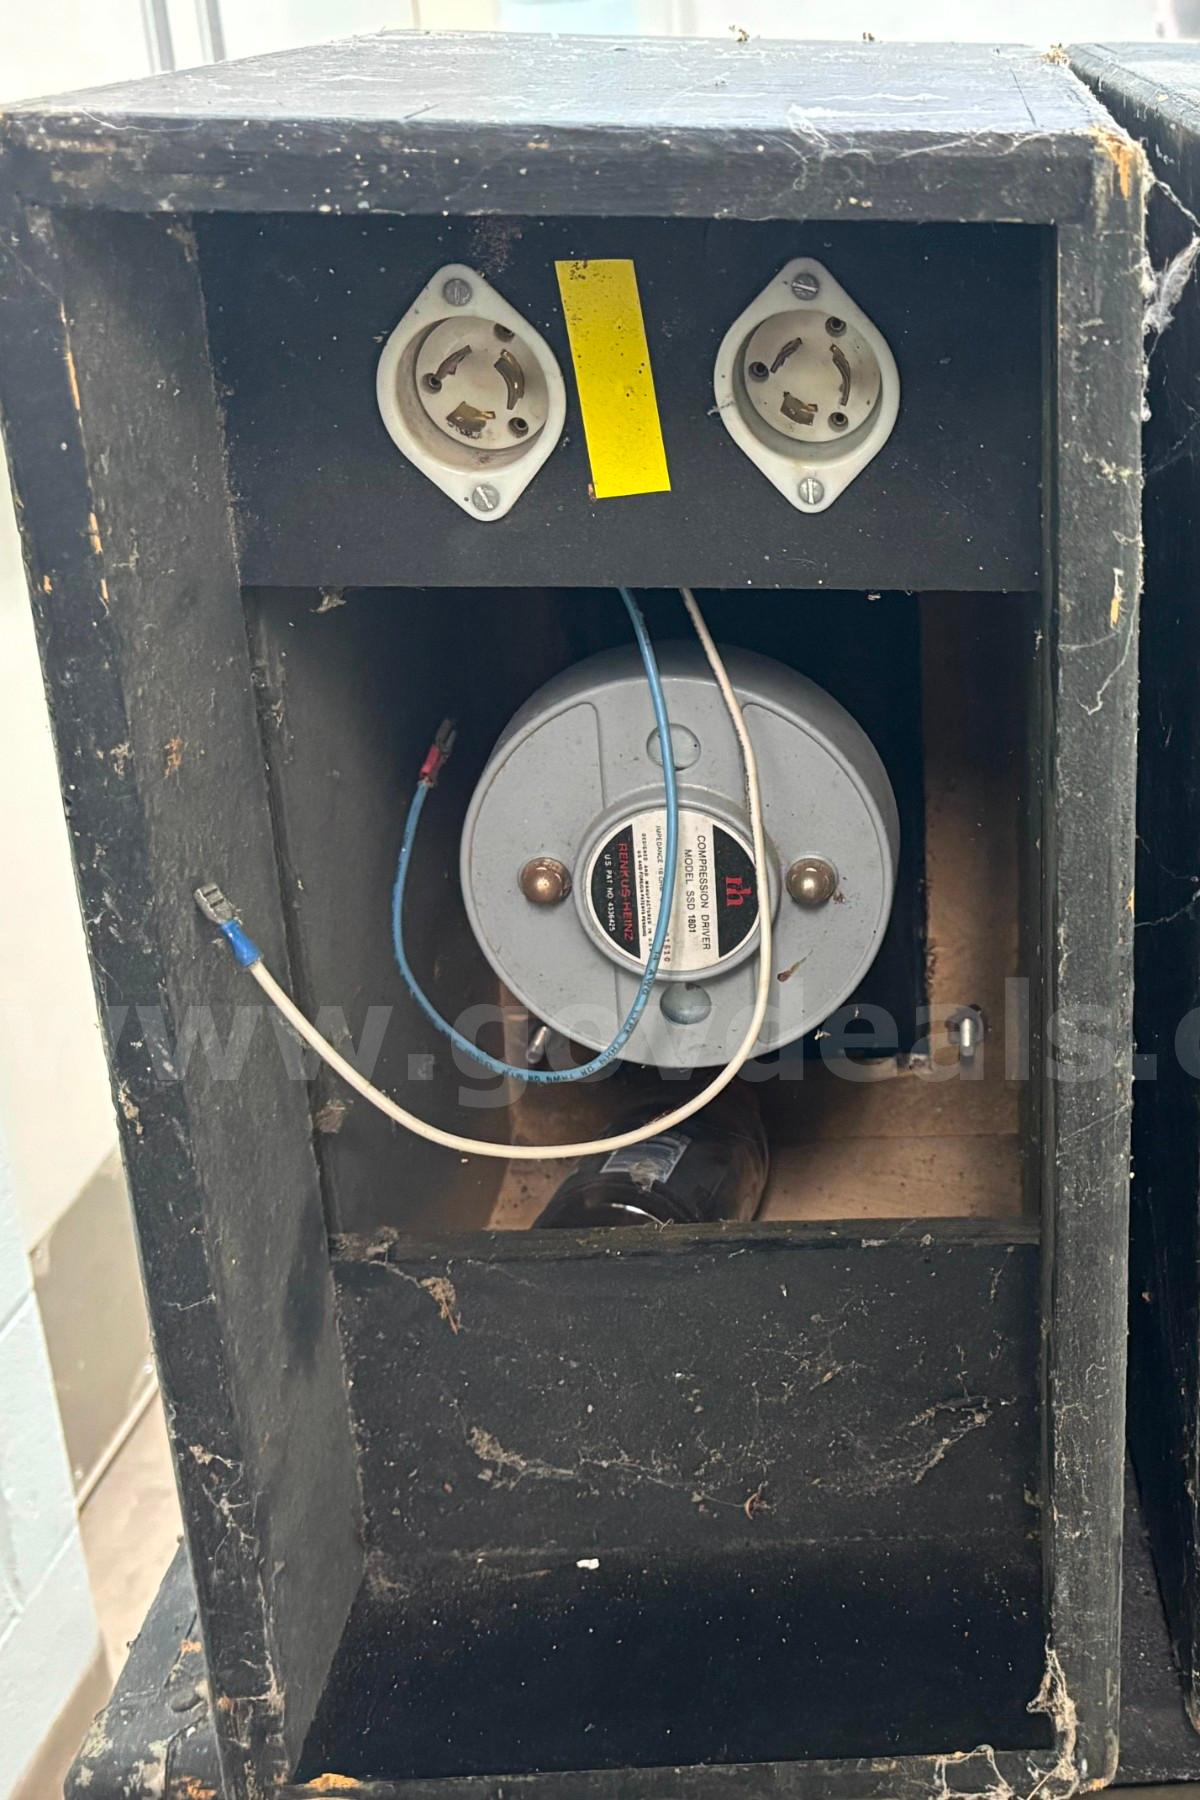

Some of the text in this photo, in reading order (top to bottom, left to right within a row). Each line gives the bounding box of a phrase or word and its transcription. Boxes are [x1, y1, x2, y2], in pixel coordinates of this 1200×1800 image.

[656, 825, 664, 863] IMPEDANCE
[618, 843, 633, 941] RENKUS-HEINZ
[684, 849, 696, 933] MODEL SSD 1801
[697, 835, 711, 950] COMPRESSION DRIVER
